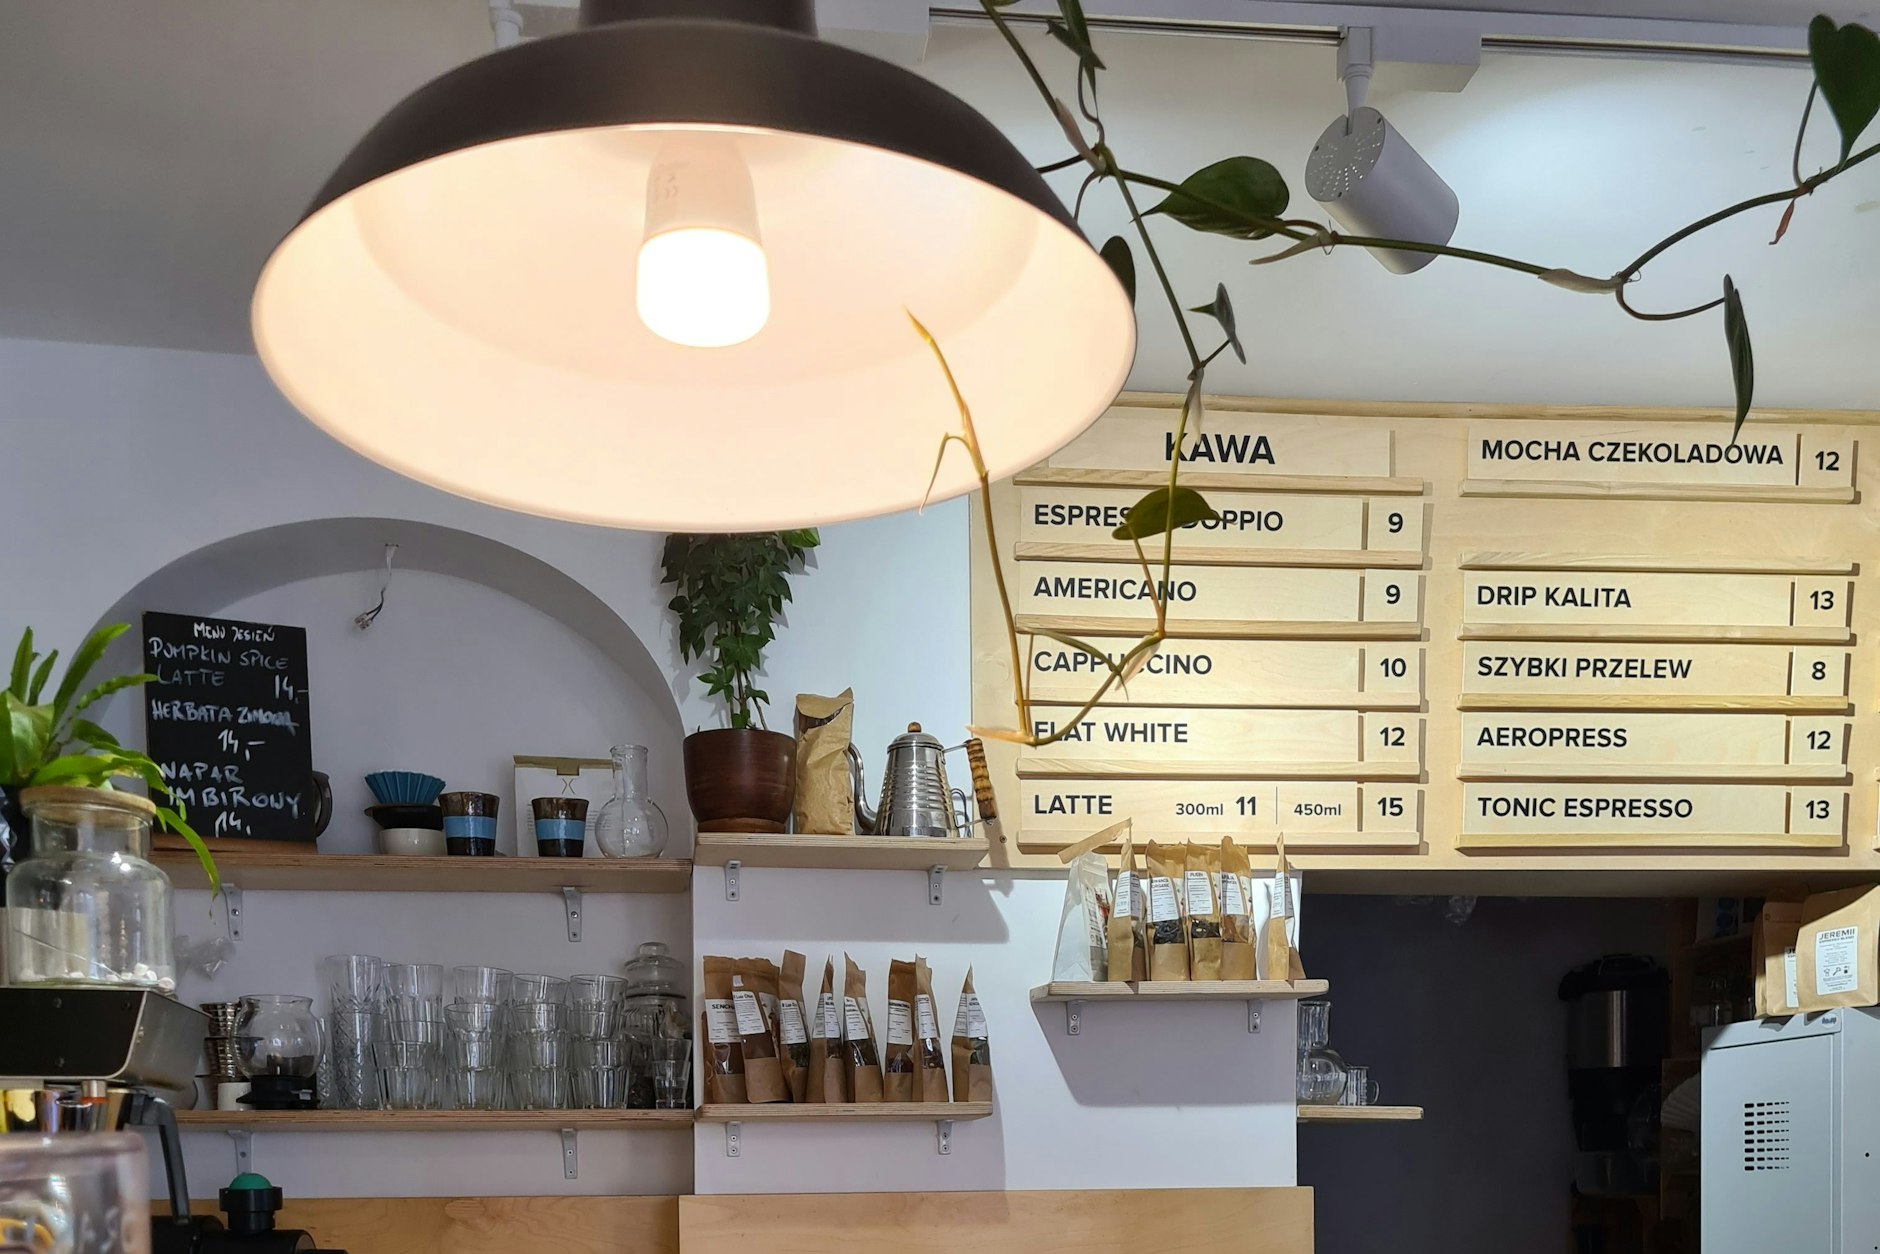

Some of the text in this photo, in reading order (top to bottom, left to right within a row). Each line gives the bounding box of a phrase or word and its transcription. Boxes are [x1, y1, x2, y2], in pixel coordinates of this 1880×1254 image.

[1166, 432, 1276, 464] KAWA
[1481, 439, 1840, 471] MOCHA CZEKOLADOWA 12
[1034, 504, 1403, 533] ESPRES OPPIO 9
[1033, 577, 1401, 605] AMERICANO 9
[1477, 585, 1835, 610] DRIP KALITA 13
[193, 622, 226, 639] MENU
[149, 636, 289, 670] PUMPKIN SPICE
[1034, 651, 1407, 678] CAPPUCINO 10
[157, 663, 225, 686] LATTE
[1477, 656, 1826, 681] SZYBKI PRZELEW 8
[152, 699, 232, 723] HERBATA
[1034, 721, 1405, 746] FLAT WHITE 12
[1477, 727, 1832, 750] AEROPRESS 12
[161, 761, 243, 783] NAPAR
[1033, 794, 1404, 817] LATTE 300ml 11 450ml 15
[1477, 797, 1830, 819] TONIC ESPRESSO 13
[1818, 928, 1855, 940] JEREMII
